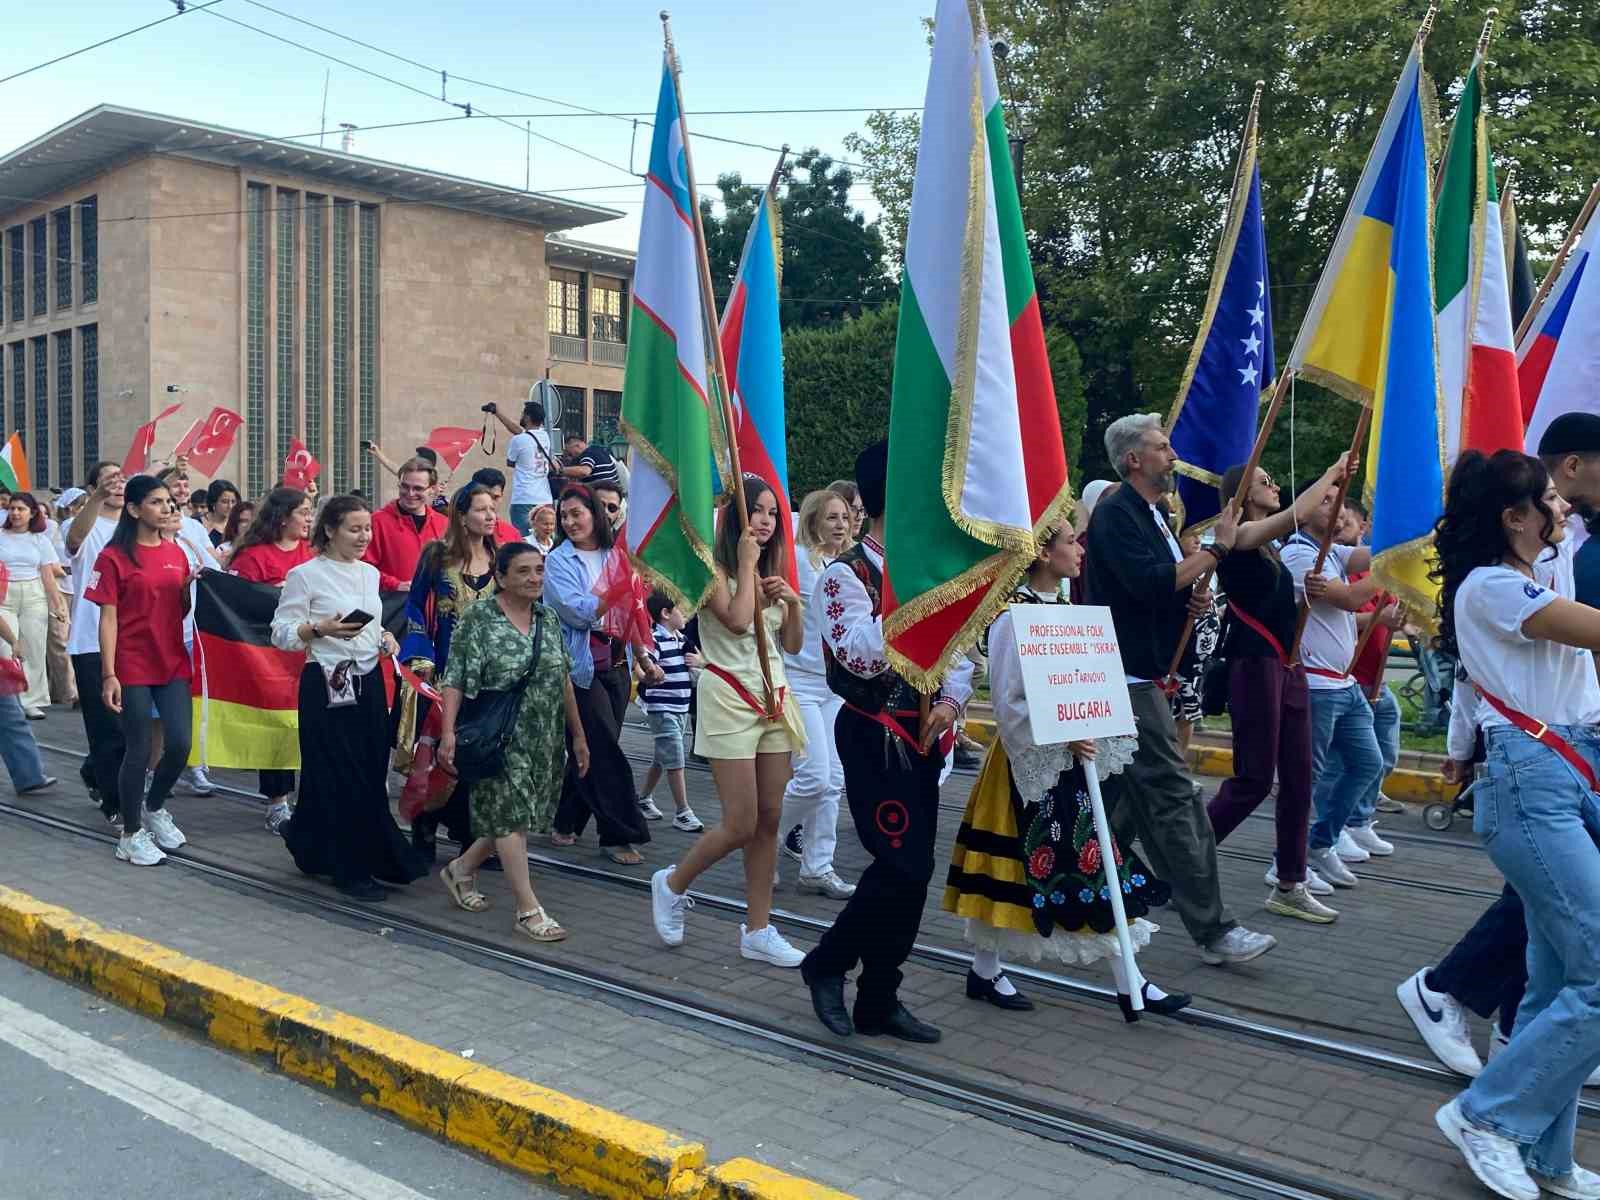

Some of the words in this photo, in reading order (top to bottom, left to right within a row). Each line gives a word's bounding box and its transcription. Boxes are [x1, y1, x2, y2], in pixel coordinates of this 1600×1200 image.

[1030, 624, 1085, 637] PROFESSIONAL
[1087, 624, 1104, 637] FOLK
[1020, 643, 1048, 656] DANCE
[1050, 642, 1088, 655] ENSEMBLE
[1048, 672, 1073, 685] VELIKO
[1057, 700, 1112, 721] BULGARIA
